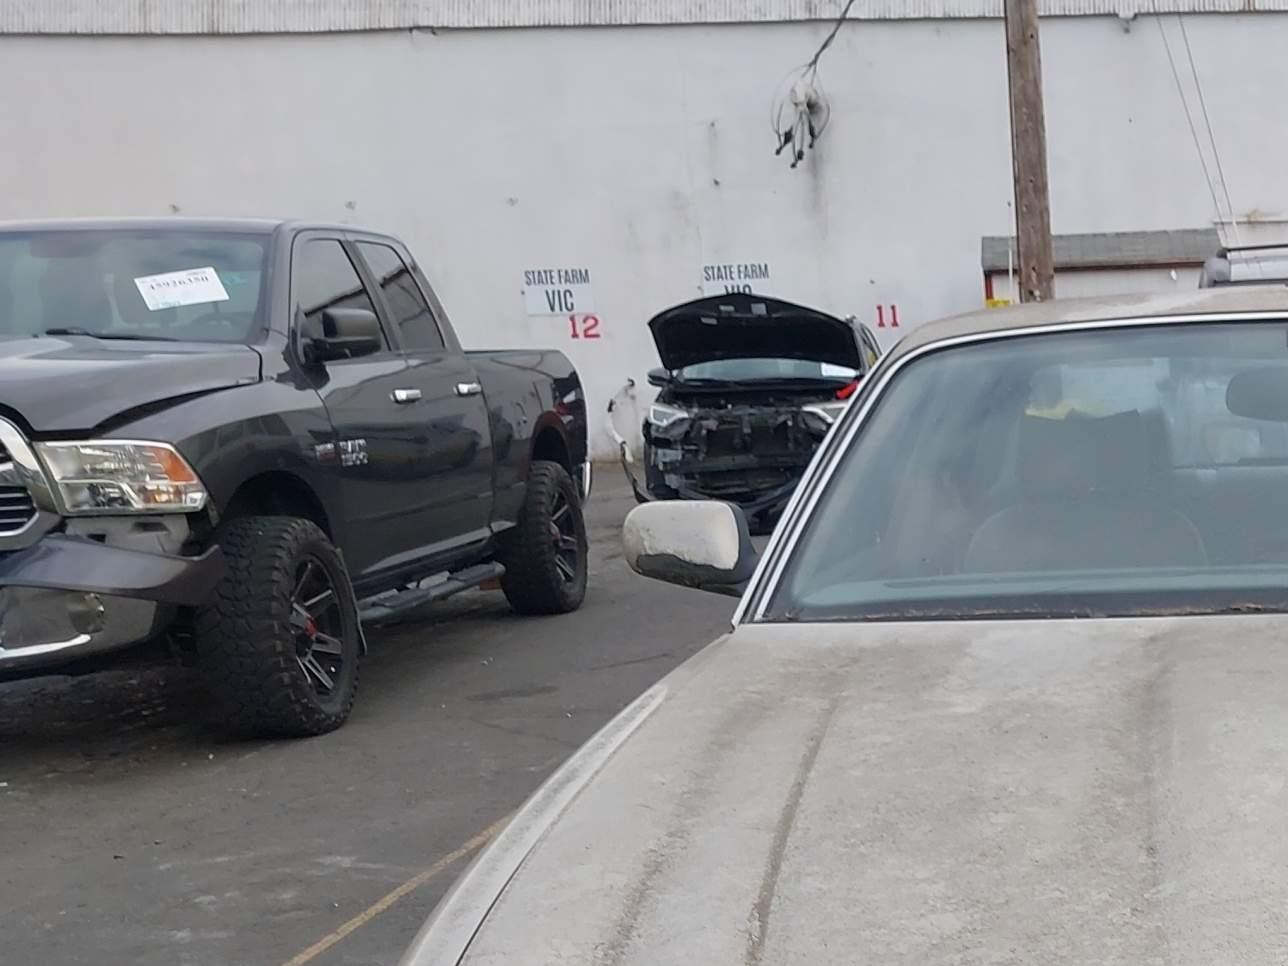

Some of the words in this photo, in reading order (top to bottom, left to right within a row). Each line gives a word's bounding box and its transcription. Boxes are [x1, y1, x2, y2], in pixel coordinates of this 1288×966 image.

[524, 269, 554, 286] STATE
[557, 268, 590, 284] FARM
[704, 265, 734, 281] STATE
[737, 263, 769, 279] FARM
[545, 289, 574, 312] VIC
[569, 314, 600, 339] 12
[876, 305, 899, 328] 11
